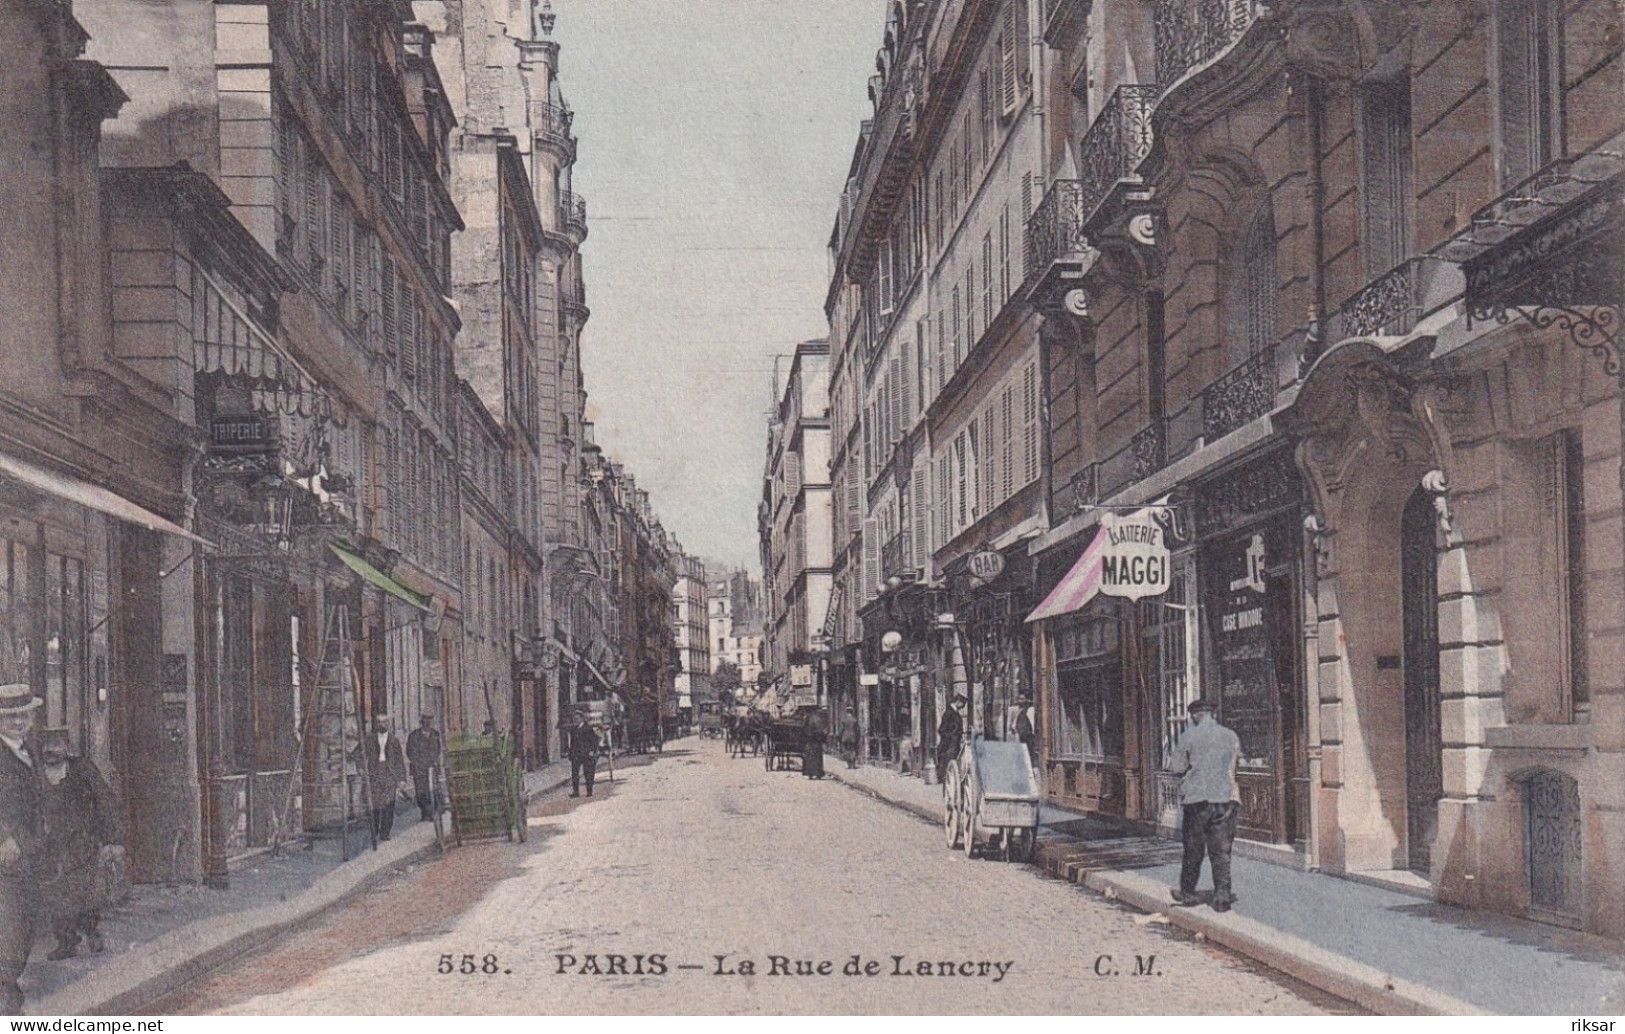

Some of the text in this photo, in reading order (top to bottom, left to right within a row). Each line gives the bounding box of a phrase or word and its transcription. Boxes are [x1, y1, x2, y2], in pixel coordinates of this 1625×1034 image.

[213, 422, 263, 440] TRIPERIE
[1107, 524, 1160, 547] LAITERIE
[974, 553, 1001, 575] BAR
[1102, 555, 1166, 586] MAGGI
